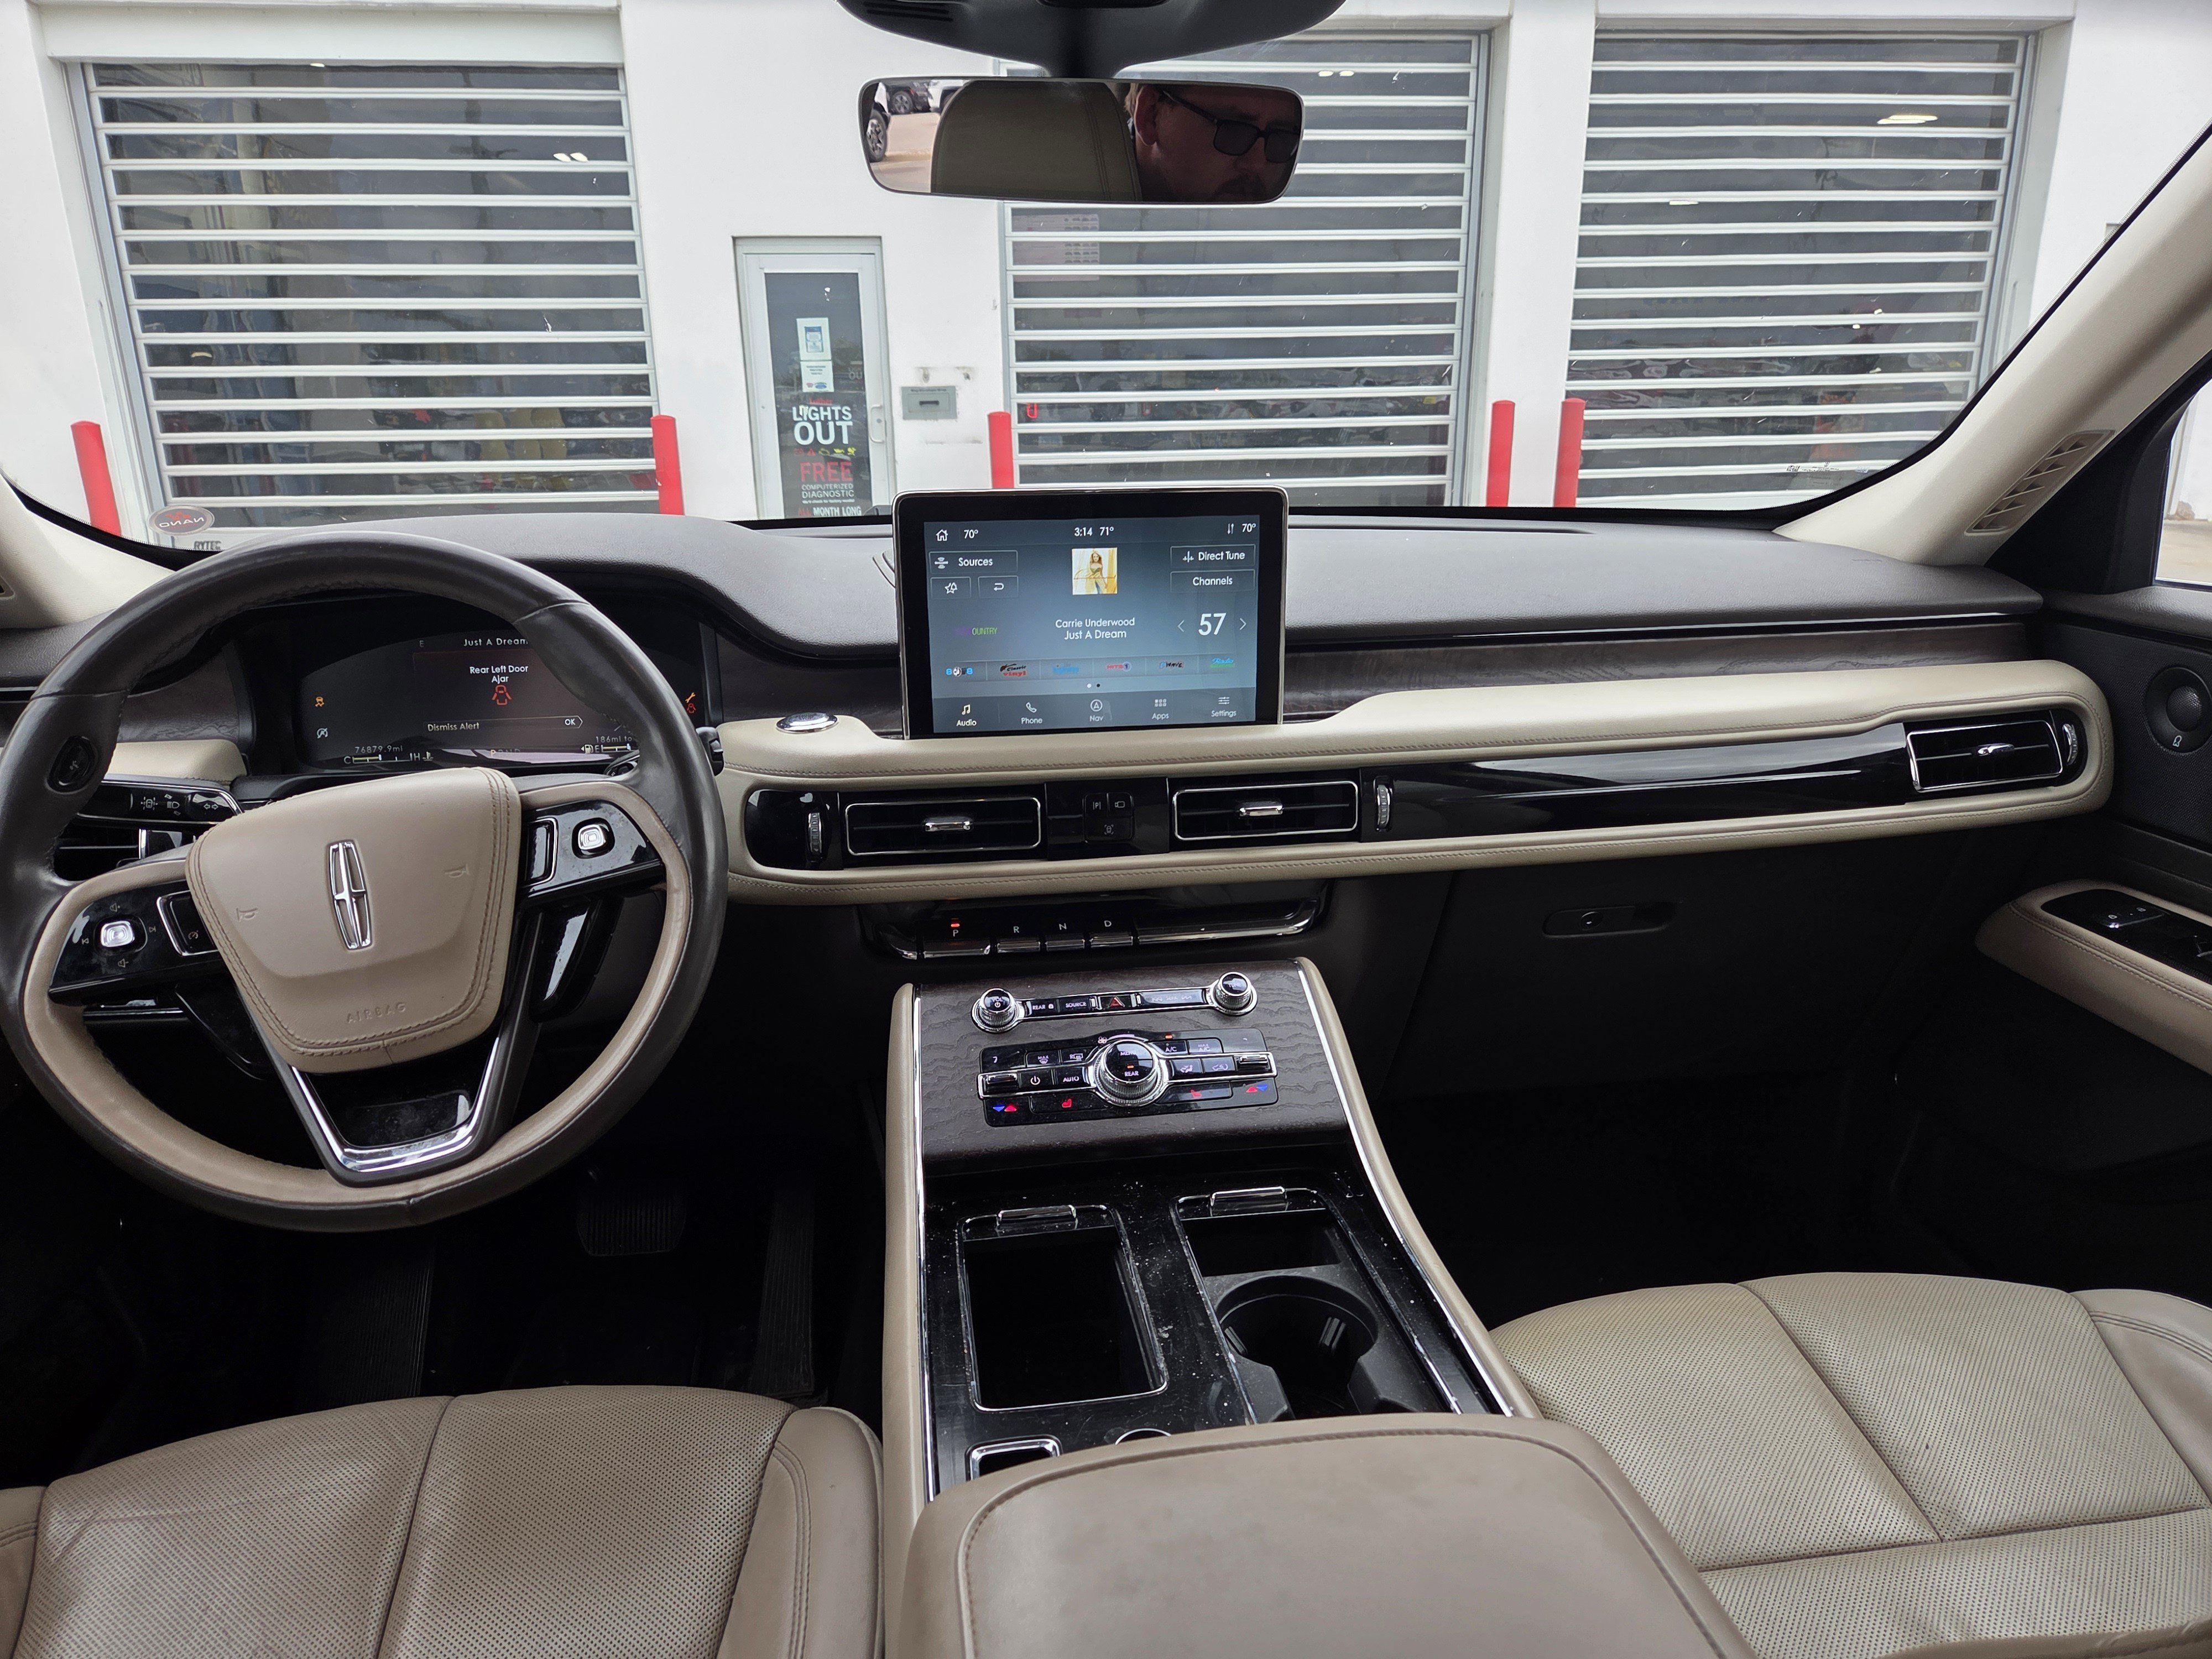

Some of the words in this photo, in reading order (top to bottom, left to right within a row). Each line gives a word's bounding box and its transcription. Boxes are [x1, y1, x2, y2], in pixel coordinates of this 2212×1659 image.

[792, 406, 852, 421] LIGHTS
[794, 421, 853, 445] OUT
[800, 462, 853, 482] FREE
[802, 490, 854, 498] DIAGNOSTIC
[813, 507, 839, 516] MONTH
[842, 505, 862, 515] LONG
[1074, 527, 1093, 536] 3:14
[1198, 551, 1224, 561] Direct
[1225, 551, 1245, 560] Tune
[958, 557, 993, 567] Sources
[1192, 576, 1233, 586] Channels
[1055, 619, 1083, 628] Carrie
[1085, 617, 1135, 627] Underwood
[1198, 613, 1227, 636] 57
[1064, 630, 1082, 640] Just
[1085, 630, 1092, 639] A
[1095, 630, 1126, 639] Dream
[469, 666, 489, 674] Rear
[491, 665, 507, 674] Left
[492, 675, 509, 684] Ajar
[1152, 713, 1169, 721] Apps
[1211, 709, 1237, 718] Settings
[427, 723, 457, 732] Dismiss
[956, 719, 977, 727] Audio
[343, 756, 352, 764] C
[414, 753, 420, 761] H
[347, 1001, 406, 1023] AIRBAG
